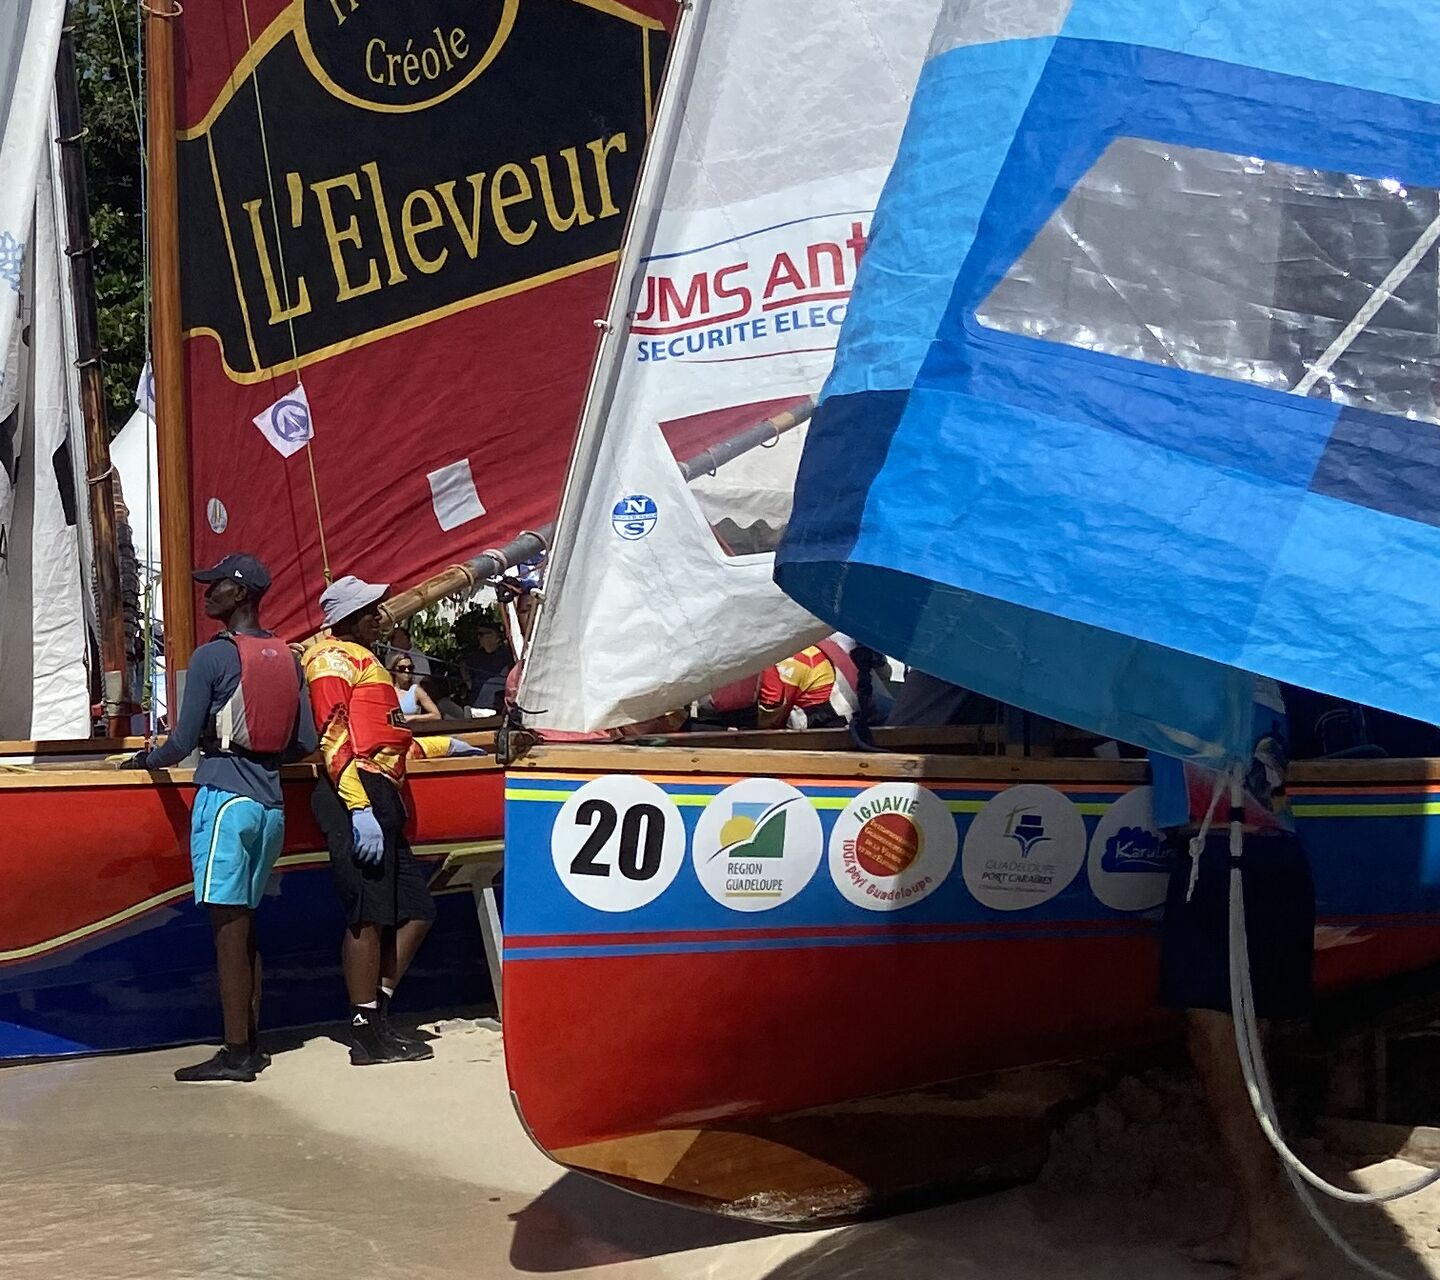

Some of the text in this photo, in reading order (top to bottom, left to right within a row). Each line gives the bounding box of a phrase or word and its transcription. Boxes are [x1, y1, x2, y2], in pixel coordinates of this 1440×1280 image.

[364, 26, 470, 87] Créole
[241, 131, 628, 326] L'Eleveur
[637, 303, 848, 362] SECURITE ELEC
[854, 796, 919, 823] IGUAVIE
[569, 798, 666, 882] 20
[725, 879, 783, 891] GUADELOUPE
[727, 862, 763, 875] REGION
[843, 839, 857, 867] 100%
[866, 876, 933, 901] Guadeloupe
[981, 871, 1007, 885] PORT
[984, 858, 1057, 874] GUADELOUPE
